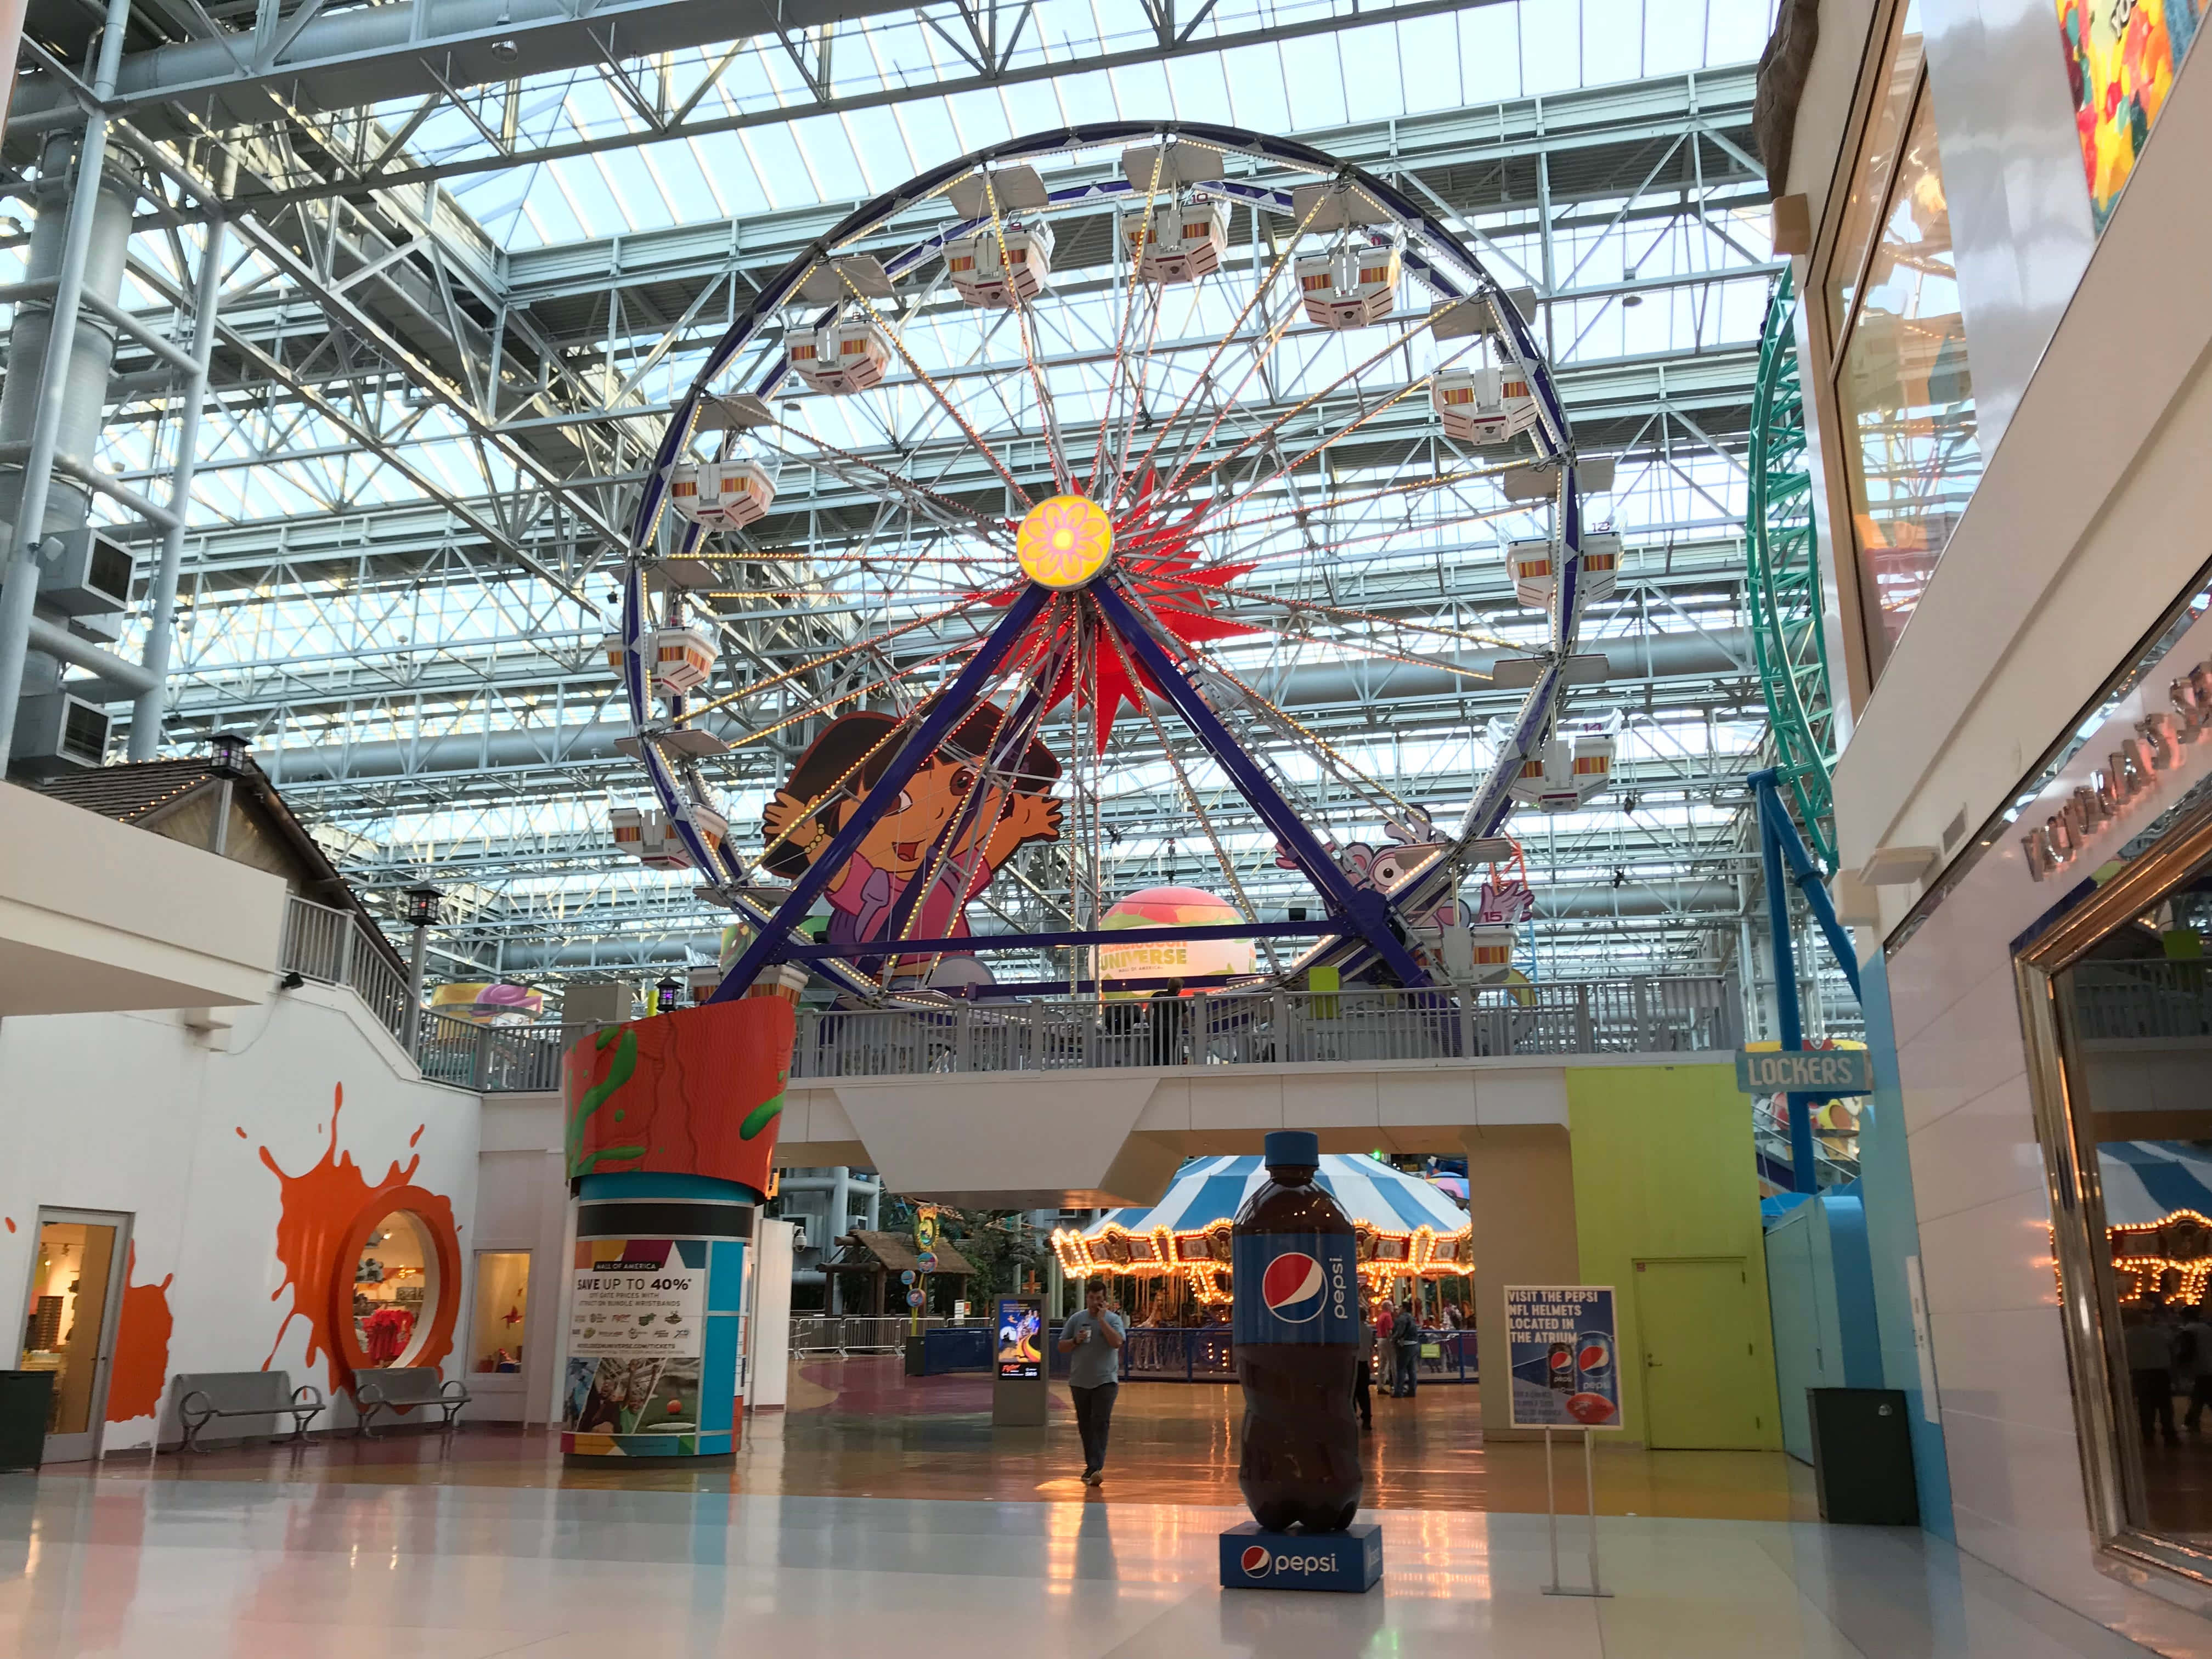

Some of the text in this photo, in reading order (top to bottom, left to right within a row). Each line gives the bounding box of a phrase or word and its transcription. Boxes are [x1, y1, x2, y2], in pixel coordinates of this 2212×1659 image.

[1192, 193, 1208, 202] 10
[1583, 723, 1603, 733] 14
[1483, 911, 1502, 922] 15
[1101, 949, 1187, 971] UNIVERSE
[1748, 1057, 1853, 1086] LOCKERS
[577, 1279, 600, 1290] SAVE
[603, 1279, 620, 1290] UP
[627, 1279, 645, 1290] TO
[1329, 1257, 1348, 1319] pepsi
[1509, 1291, 1598, 1302] VISIT THE PEPSI
[1509, 1305, 1582, 1316] NFL HELMETS
[1510, 1318, 1574, 1329] LOCATED IN
[1510, 1331, 1578, 1343] THE ATRIUM
[1275, 1554, 1336, 1576] pepsi
